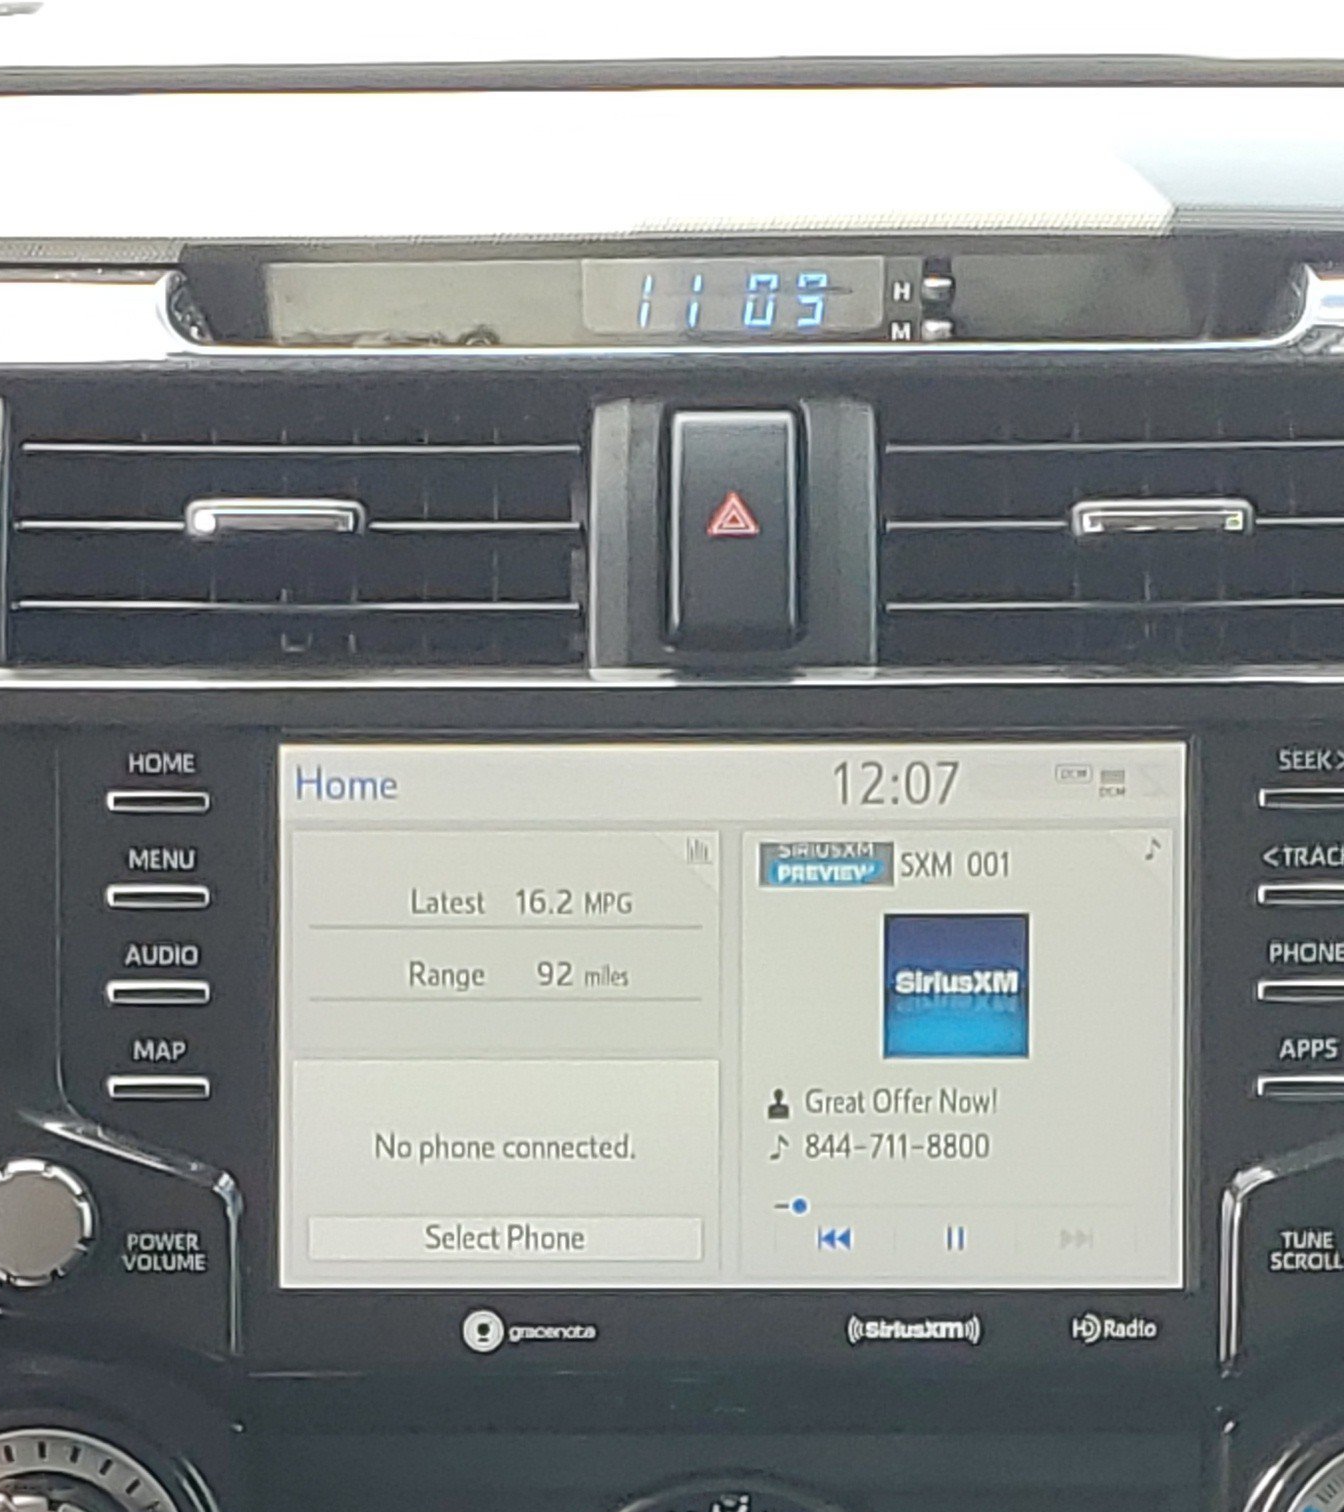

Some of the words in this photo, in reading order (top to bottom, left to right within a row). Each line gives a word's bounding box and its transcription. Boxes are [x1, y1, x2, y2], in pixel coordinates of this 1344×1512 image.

[893, 282, 910, 301] H
[892, 322, 911, 340] M
[128, 753, 196, 774] HOME
[295, 765, 398, 800] Home
[833, 760, 961, 806] 12:07
[128, 849, 196, 870] MENU
[901, 851, 953, 878] SXM
[967, 851, 1010, 878] 001
[410, 887, 486, 915] Latest
[515, 888, 574, 915] 16.2
[584, 891, 633, 915] MPG
[124, 944, 200, 966] AUDIO
[408, 960, 486, 991] Range
[536, 960, 574, 987] 92
[584, 963, 630, 988] miles
[895, 969, 1020, 995] SiriusXM
[132, 1039, 187, 1061] MAP
[1279, 1038, 1339, 1059] APPS
[805, 1087, 865, 1115] Great
[873, 1087, 934, 1115] Offer
[940, 1087, 999, 1115] Now!
[374, 1132, 412, 1160] No
[419, 1132, 496, 1165] phone
[502, 1132, 637, 1160] connected.
[805, 1132, 990, 1160] 844-711-8800
[127, 1233, 199, 1251] POWER
[424, 1224, 500, 1251] Select
[507, 1224, 585, 1251] Phone
[1280, 1231, 1334, 1250] TUNE
[121, 1253, 207, 1272] VOLUME
[1104, 1318, 1157, 1339] Radio
